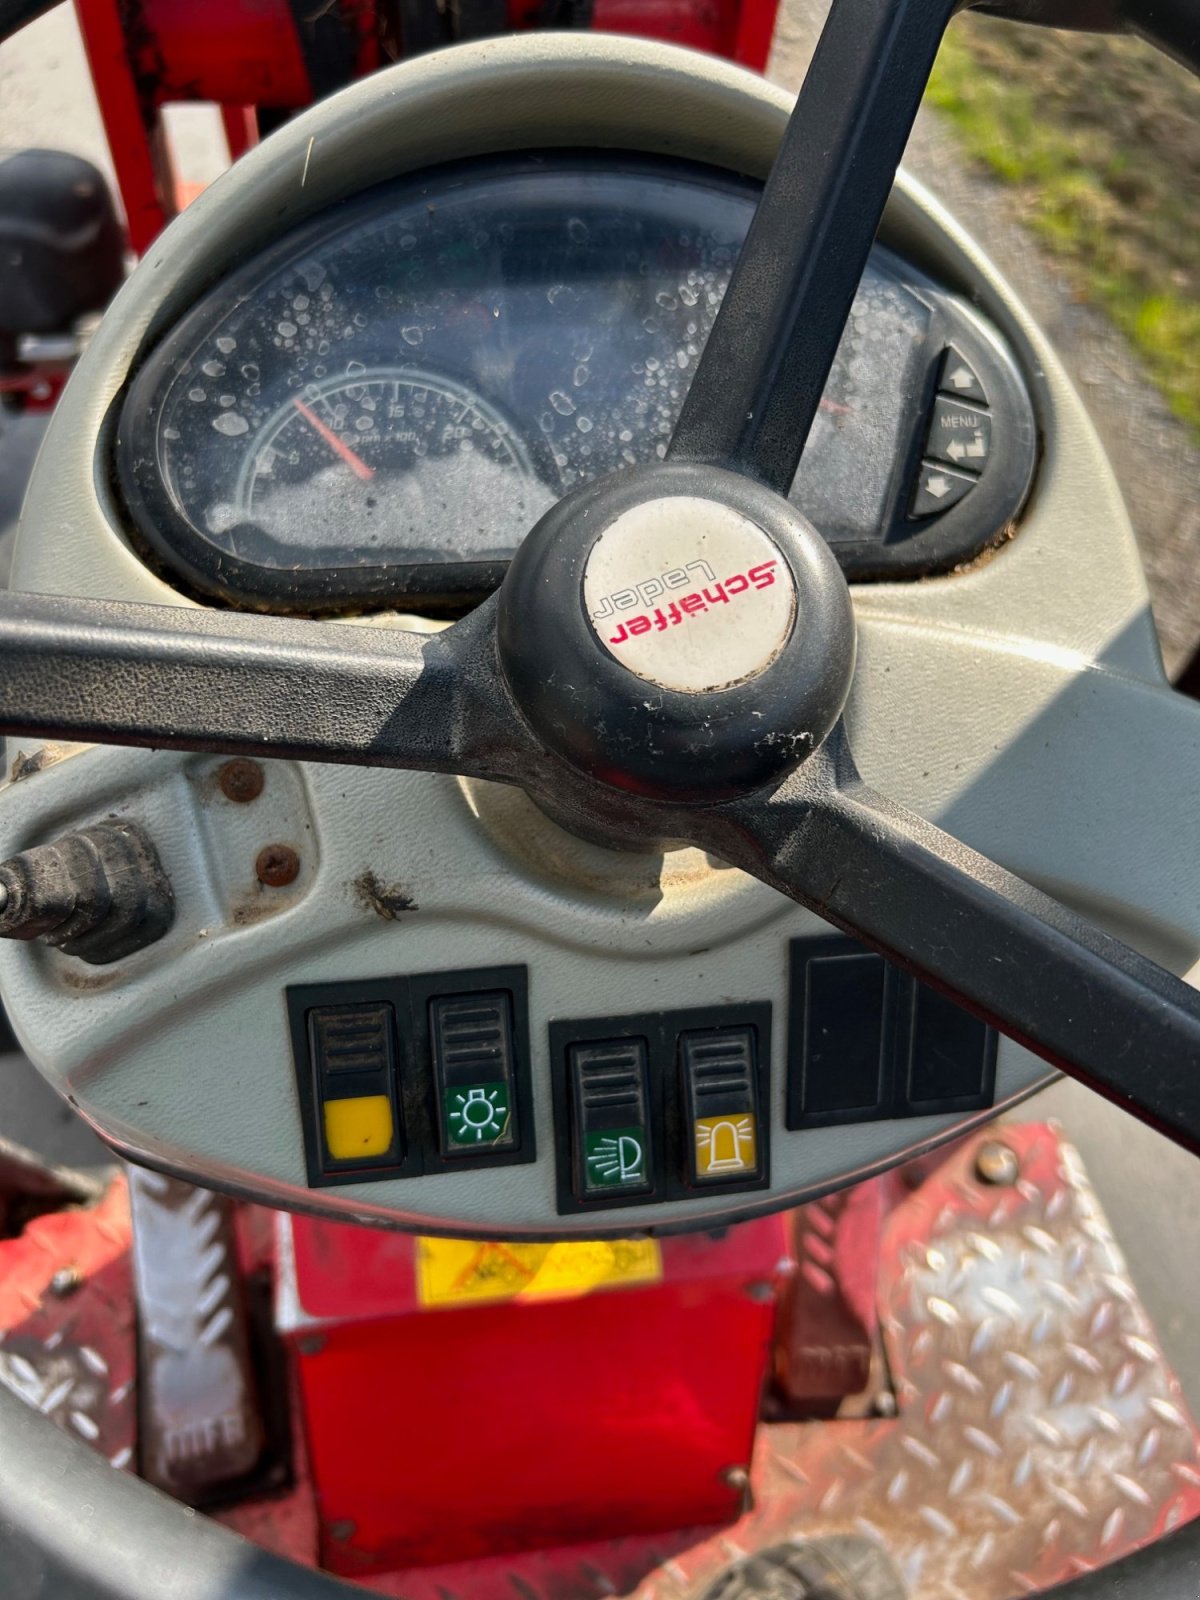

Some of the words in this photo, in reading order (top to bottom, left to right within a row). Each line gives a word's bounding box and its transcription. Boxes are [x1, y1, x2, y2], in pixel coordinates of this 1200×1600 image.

[940, 415, 978, 428] MENU
[593, 558, 716, 619] Lader
[609, 559, 778, 644] Schäffer
